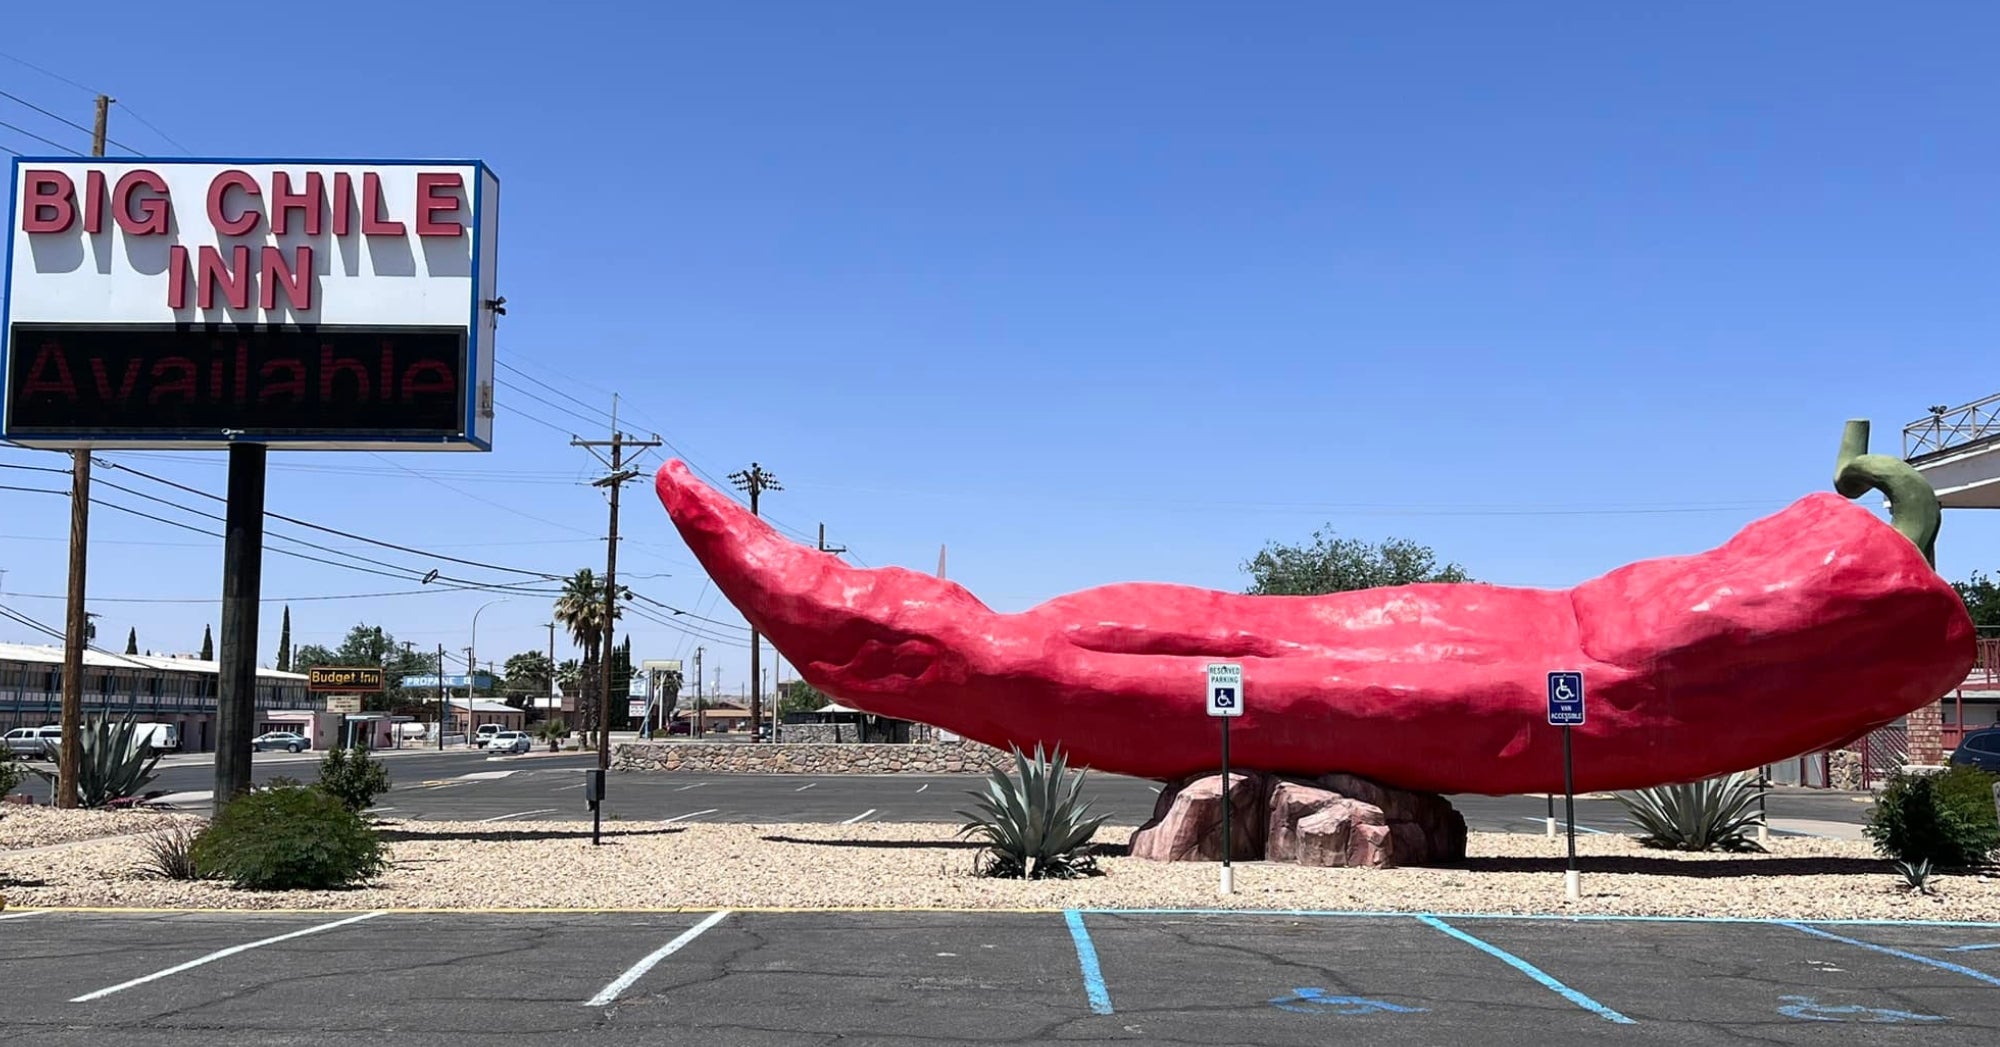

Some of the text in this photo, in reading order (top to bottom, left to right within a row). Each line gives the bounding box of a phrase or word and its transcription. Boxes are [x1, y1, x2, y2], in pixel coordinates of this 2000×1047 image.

[22, 169, 463, 236] BIG CHILE
[168, 245, 313, 310] INN
[22, 337, 456, 402] Available
[312, 671, 378, 685] Budget Inn
[1209, 666, 1240, 674] RESERVED
